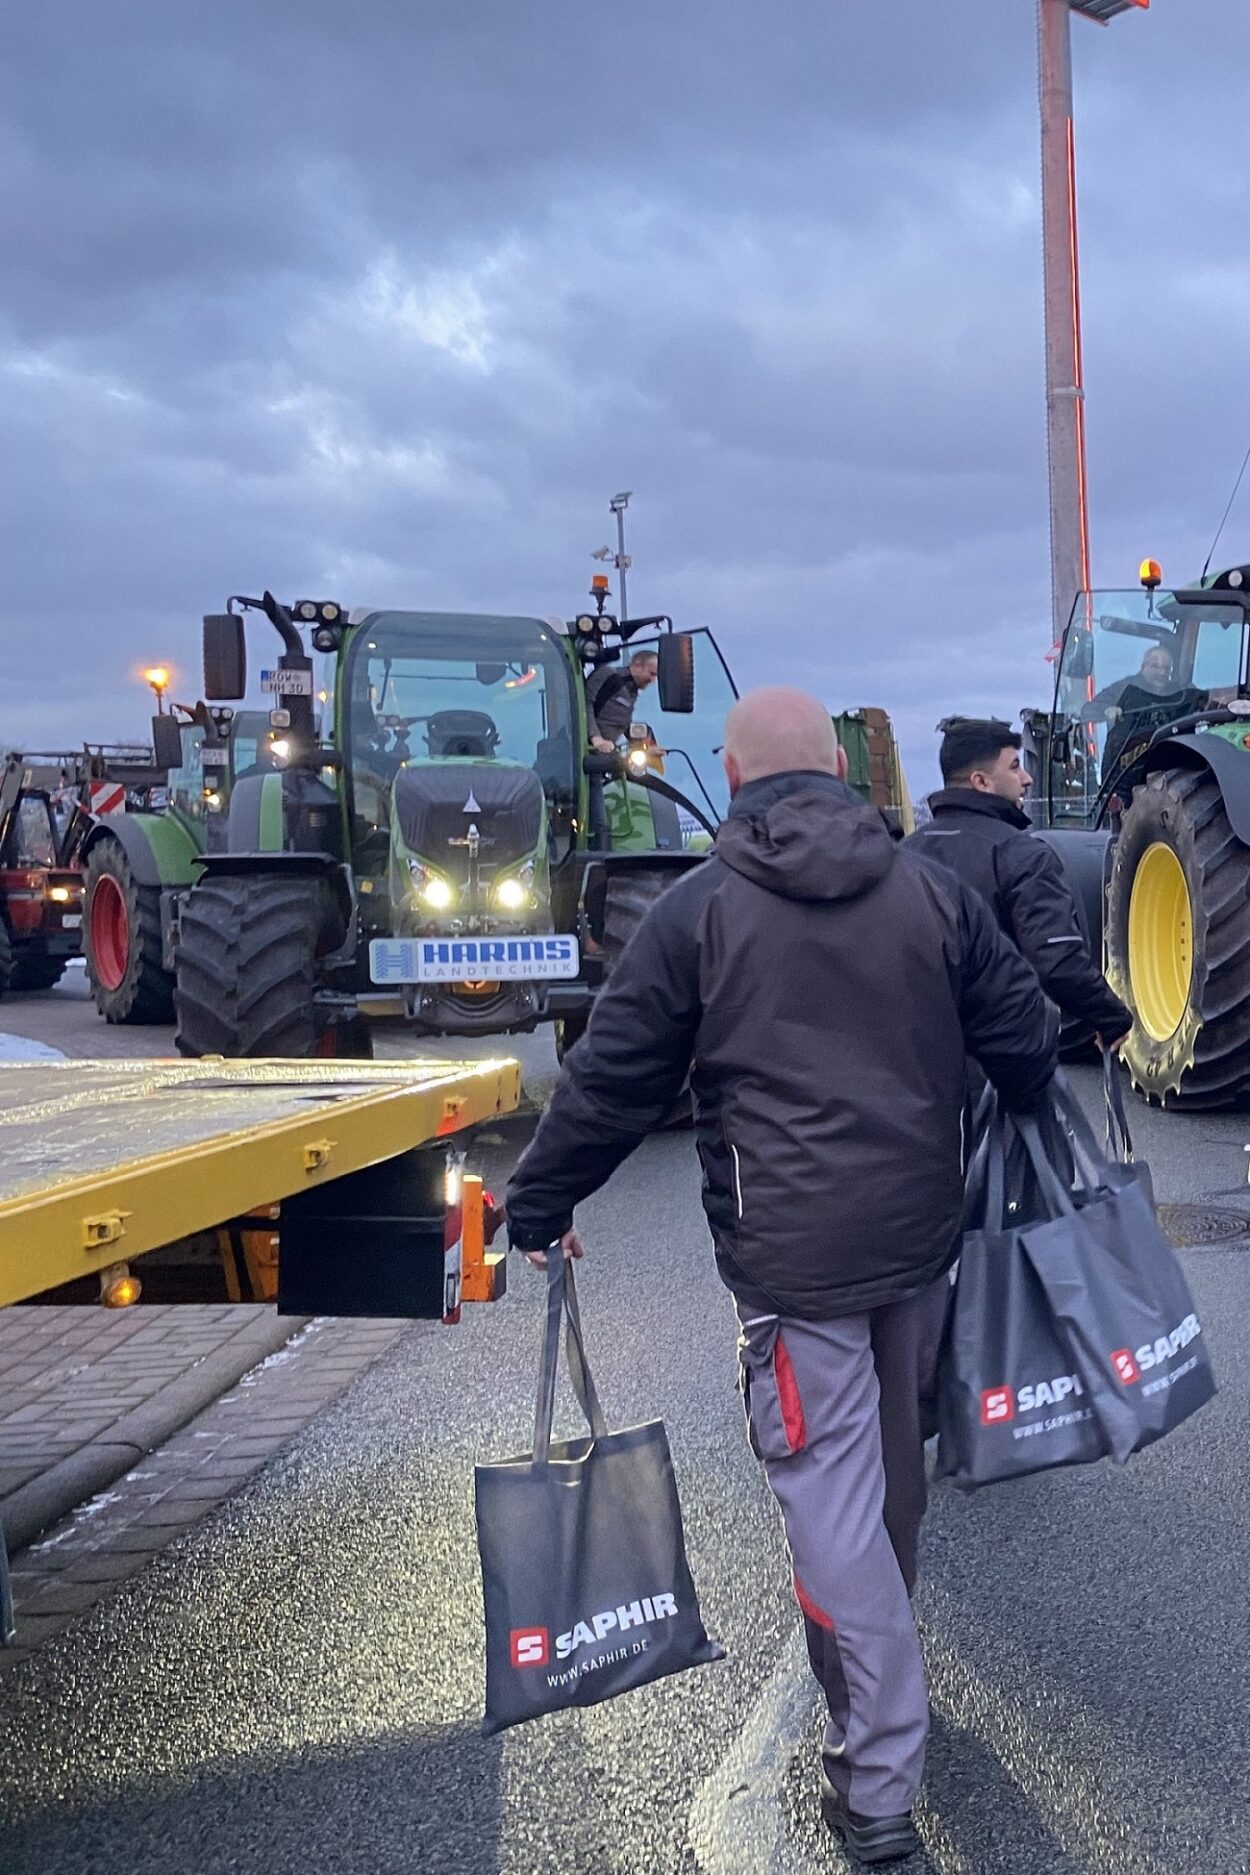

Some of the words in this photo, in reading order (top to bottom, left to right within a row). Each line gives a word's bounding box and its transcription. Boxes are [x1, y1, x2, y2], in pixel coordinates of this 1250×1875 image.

[424, 940, 571, 964] HARMS
[424, 963, 571, 977] LANDTECHNIK
[555, 1592, 678, 1659] SAPHIR
